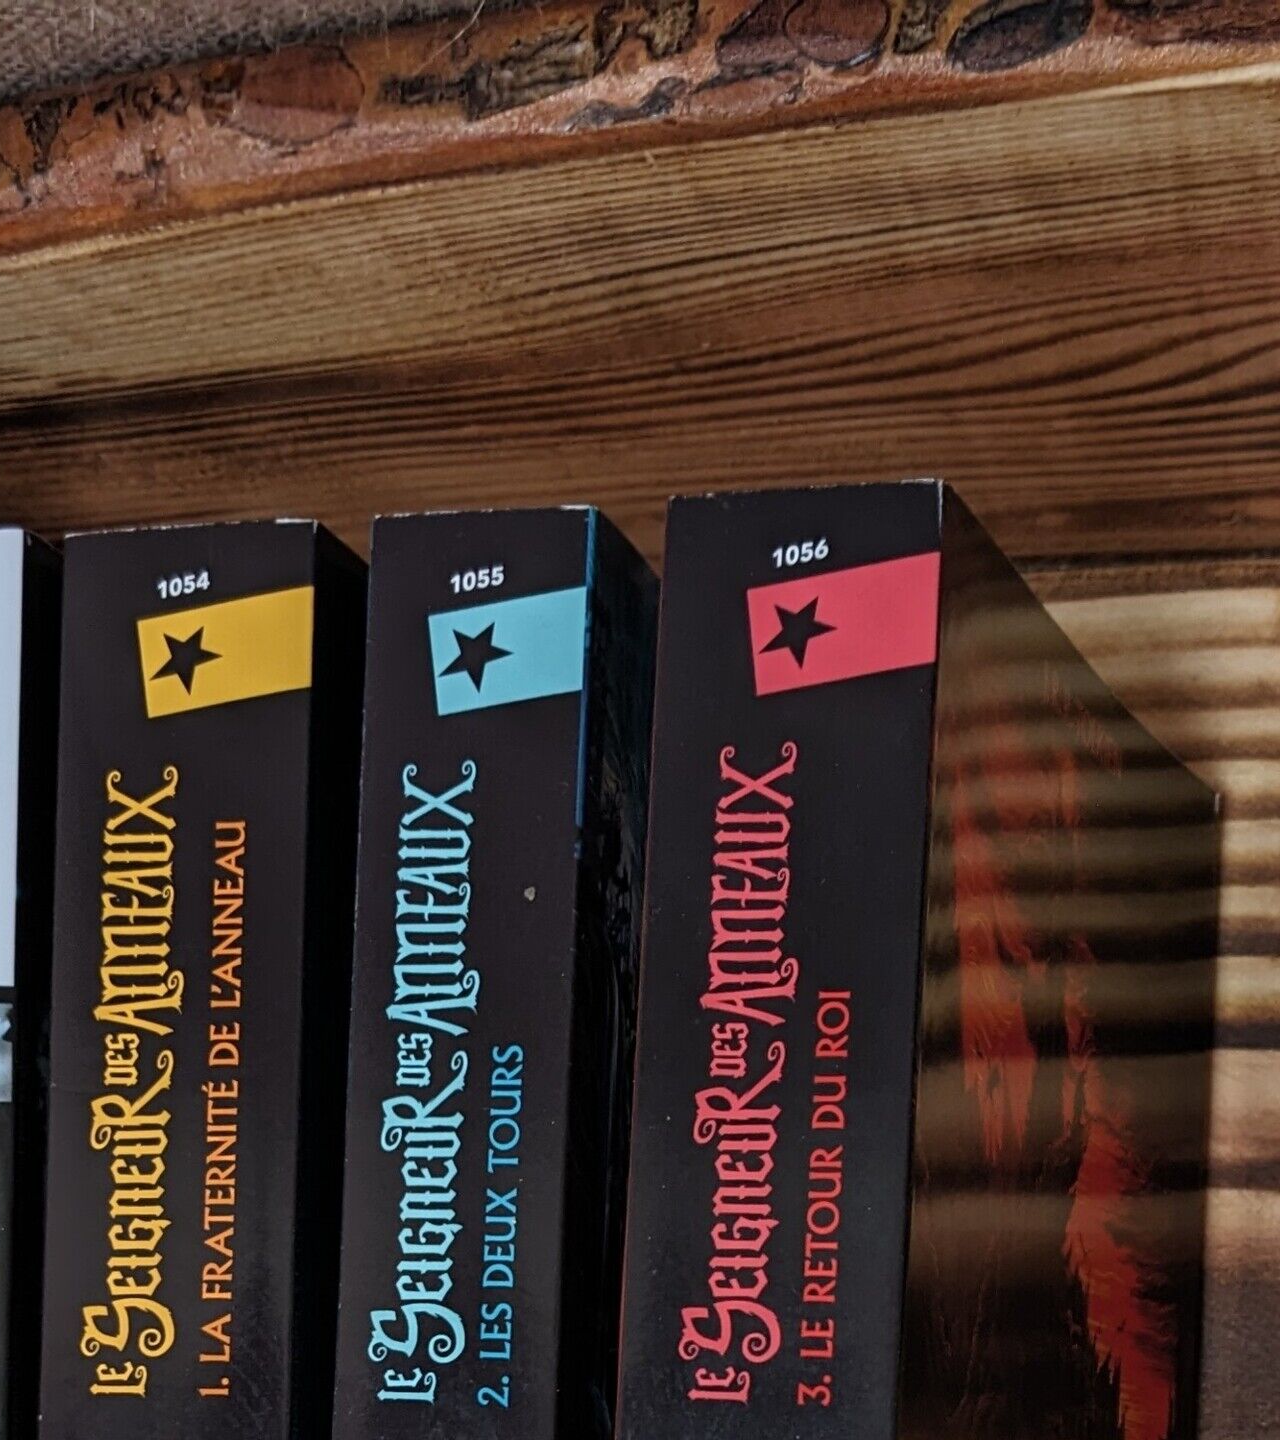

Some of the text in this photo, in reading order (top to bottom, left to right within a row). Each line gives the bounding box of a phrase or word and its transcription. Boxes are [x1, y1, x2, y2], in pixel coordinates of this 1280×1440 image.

[157, 571, 210, 599] 1054
[450, 565, 505, 594] 1055
[773, 539, 830, 568] 1056
[80, 766, 185, 1398] LE SEIGNEUR DES ANNEAUX
[198, 819, 246, 1398] 1. LA FRATERNITÉ DE L'ANNEAU
[368, 759, 481, 1404] LE SEIGNEUR DES ANNEAUX
[477, 1043, 525, 1409] 2. LES DEUX TOURS
[678, 741, 800, 1404] LE SEIGNEUR DES ANNEAUX
[797, 990, 851, 1407] 3. LE RETOUR DU ROI
